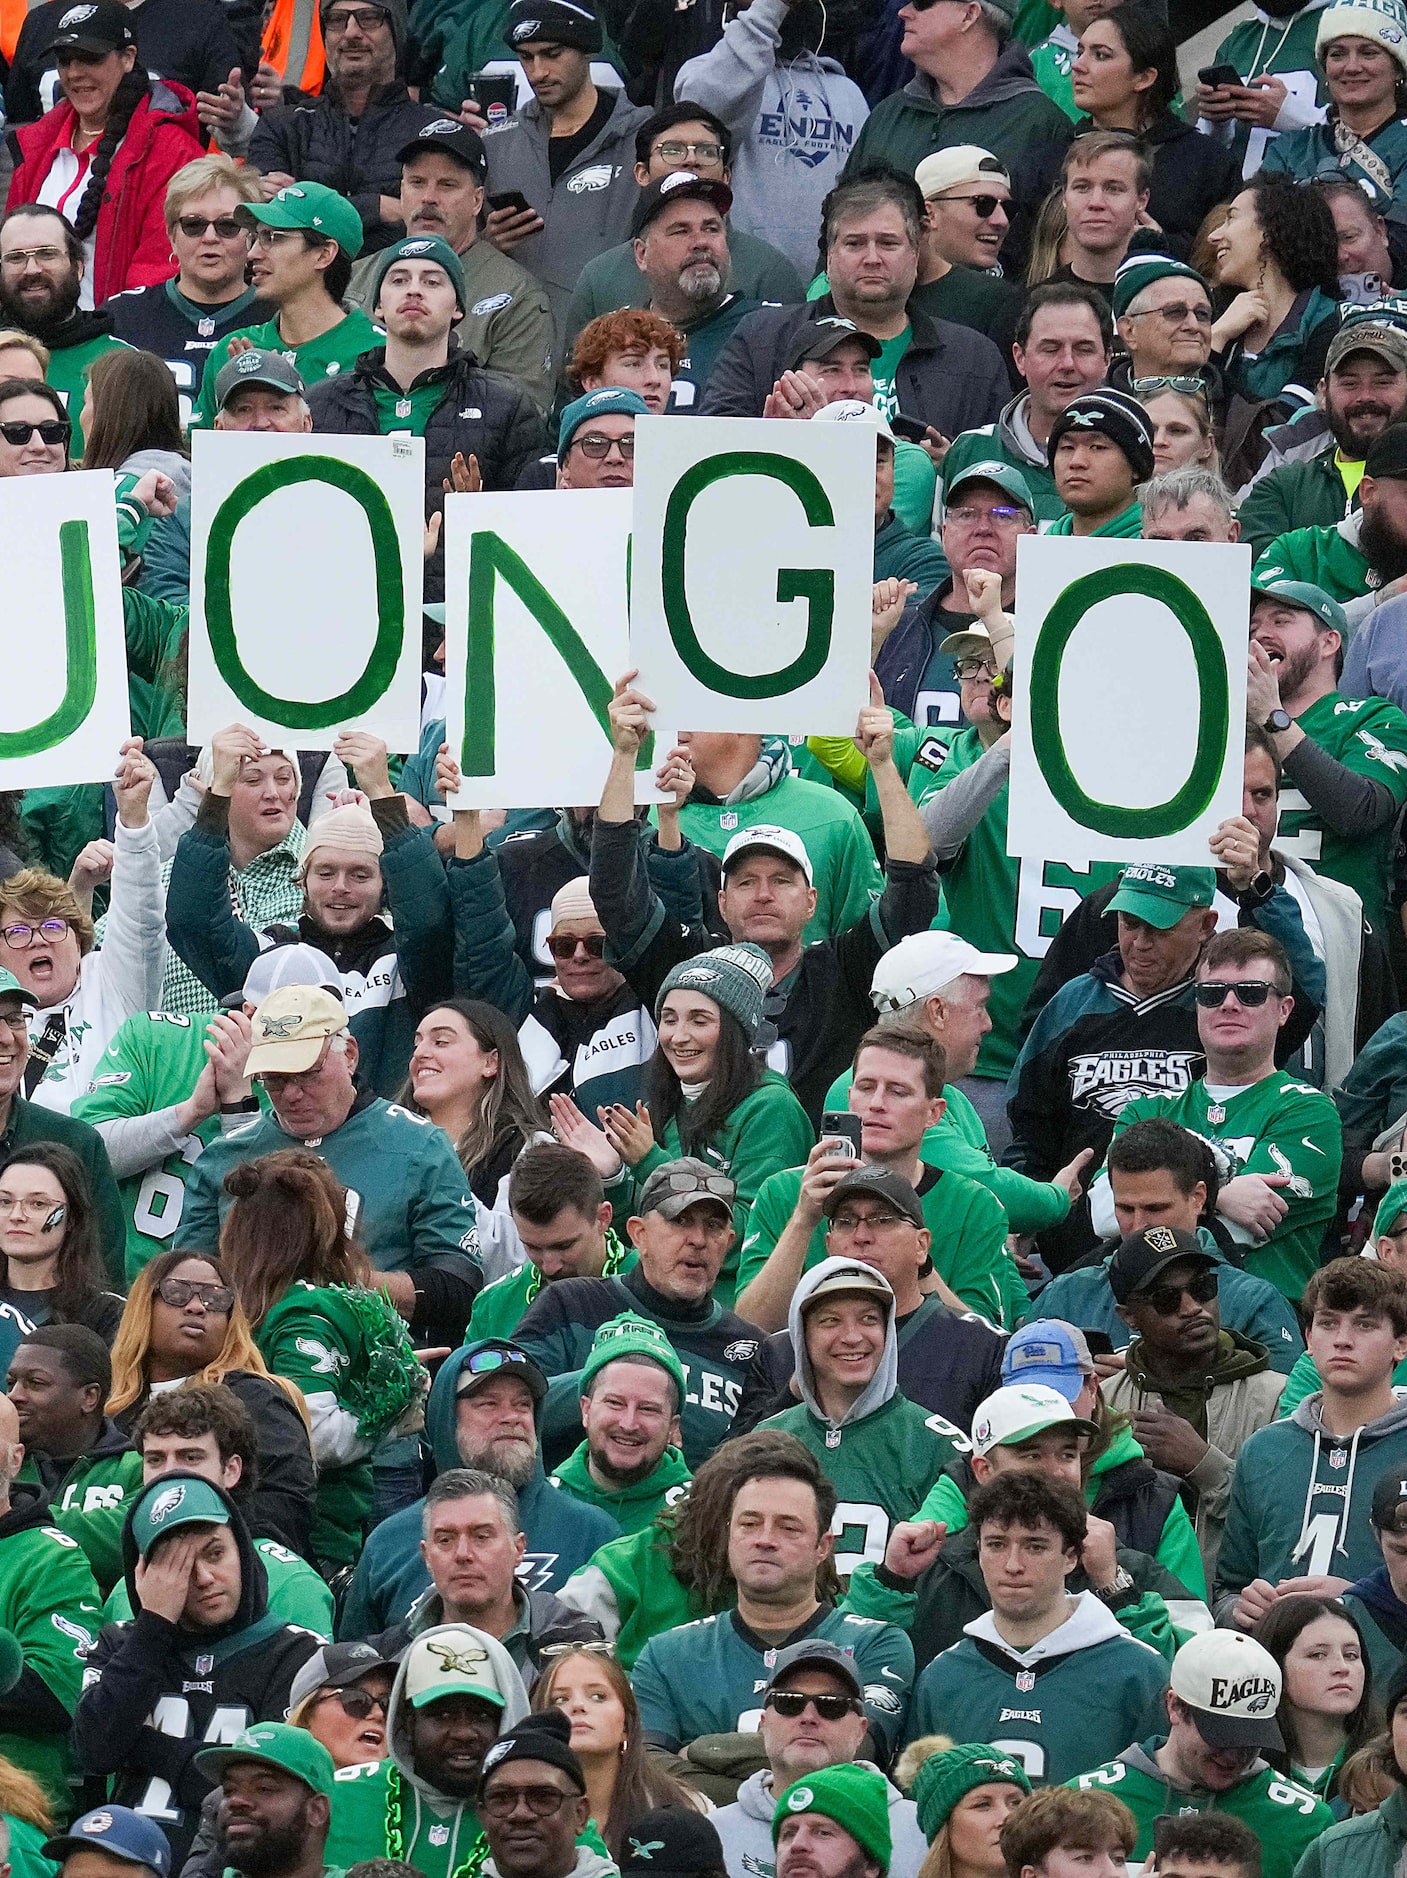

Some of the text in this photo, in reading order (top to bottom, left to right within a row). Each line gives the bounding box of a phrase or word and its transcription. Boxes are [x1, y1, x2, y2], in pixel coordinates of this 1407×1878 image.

[759, 113, 854, 146] ENON
[759, 138, 799, 148] EAGLS
[662, 452, 834, 699] G
[205, 454, 404, 729] O
[460, 531, 655, 777] N
[1030, 562, 1230, 839] O
[1125, 867, 1177, 888] EAGLES
[345, 973, 391, 999] EALES
[584, 1032, 636, 1061] EAGLES
[1108, 1051, 1166, 1061] PHILADELPHIA
[1075, 1057, 1192, 1101] EAGLES
[1313, 1482, 1349, 1497] EAGLES
[1211, 1677, 1276, 1709] EAGLES
[999, 1708, 1041, 1724] EAGLES
